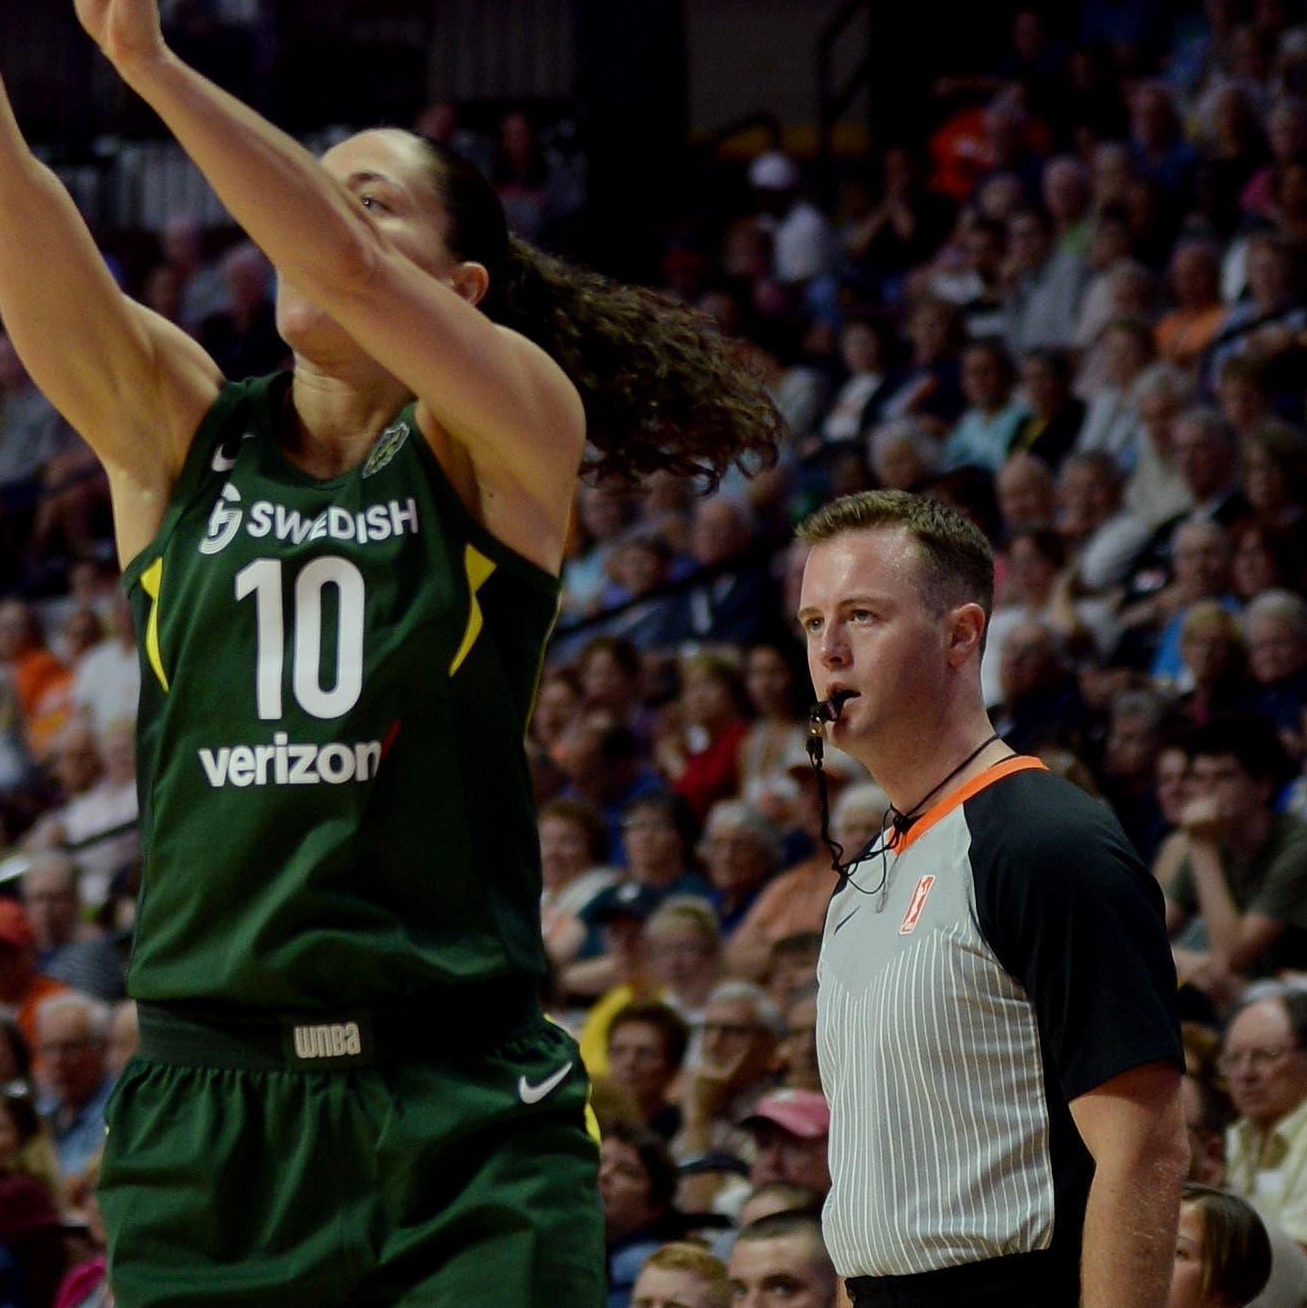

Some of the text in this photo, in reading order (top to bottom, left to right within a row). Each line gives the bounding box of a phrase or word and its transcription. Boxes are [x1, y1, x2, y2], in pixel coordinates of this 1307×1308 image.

[246, 497, 420, 545] SWEDISH
[234, 555, 366, 722] 10
[197, 731, 383, 788] verizon
